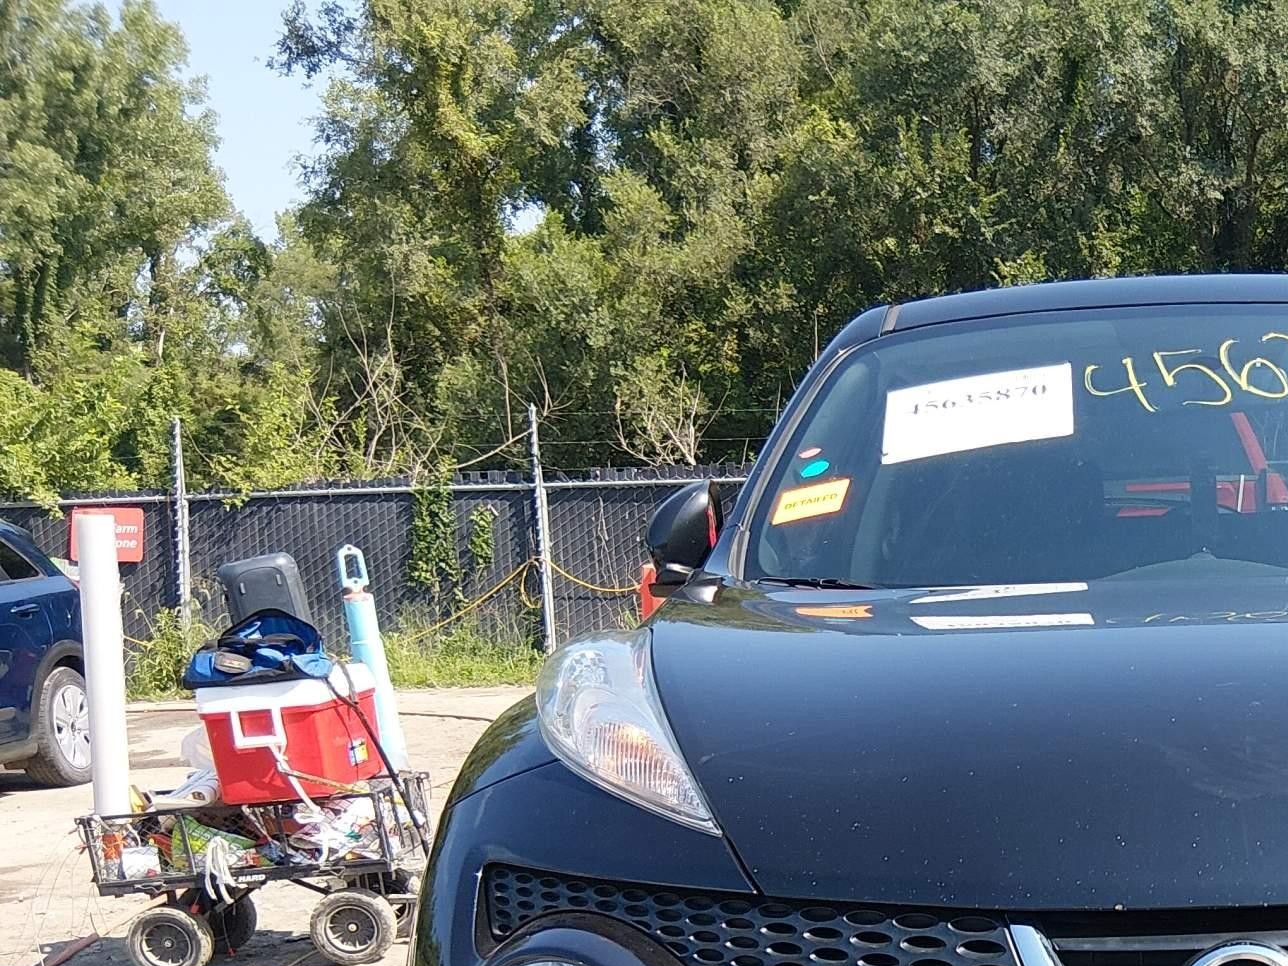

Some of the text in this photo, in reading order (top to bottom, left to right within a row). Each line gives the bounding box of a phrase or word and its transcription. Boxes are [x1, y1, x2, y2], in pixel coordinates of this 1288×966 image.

[784, 493, 838, 510] DETAILED
[114, 524, 138, 534] arm
[114, 539, 138, 549] one
[238, 874, 266, 883] HARD
